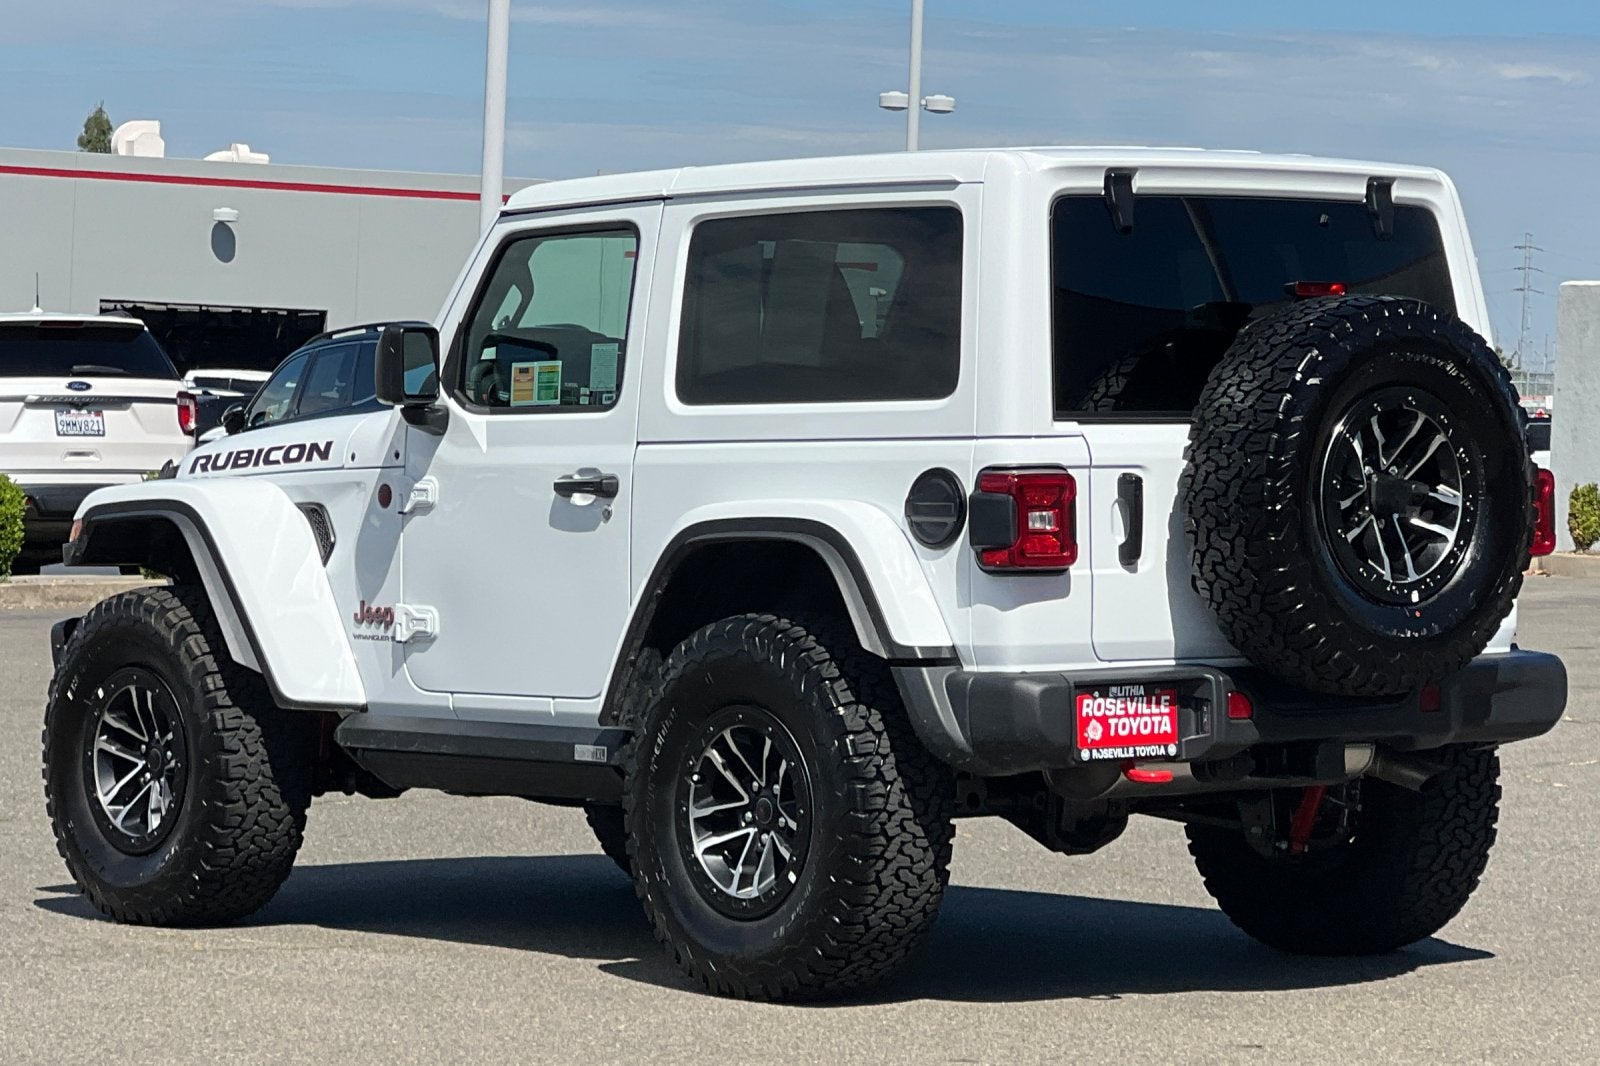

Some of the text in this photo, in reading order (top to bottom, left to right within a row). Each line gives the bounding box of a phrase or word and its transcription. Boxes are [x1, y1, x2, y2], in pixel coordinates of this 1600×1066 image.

[60, 420, 101, 432] 9MMV821
[188, 441, 334, 474] RUBICON
[353, 600, 395, 633] Jeep
[353, 633, 390, 642] WRANGLER
[1117, 685, 1144, 696] LITHIA
[1082, 695, 1170, 717] ROSEVILLE
[1108, 716, 1171, 736] TOYOTA
[1092, 745, 1166, 759] ROSEVILLE TOYOTA
